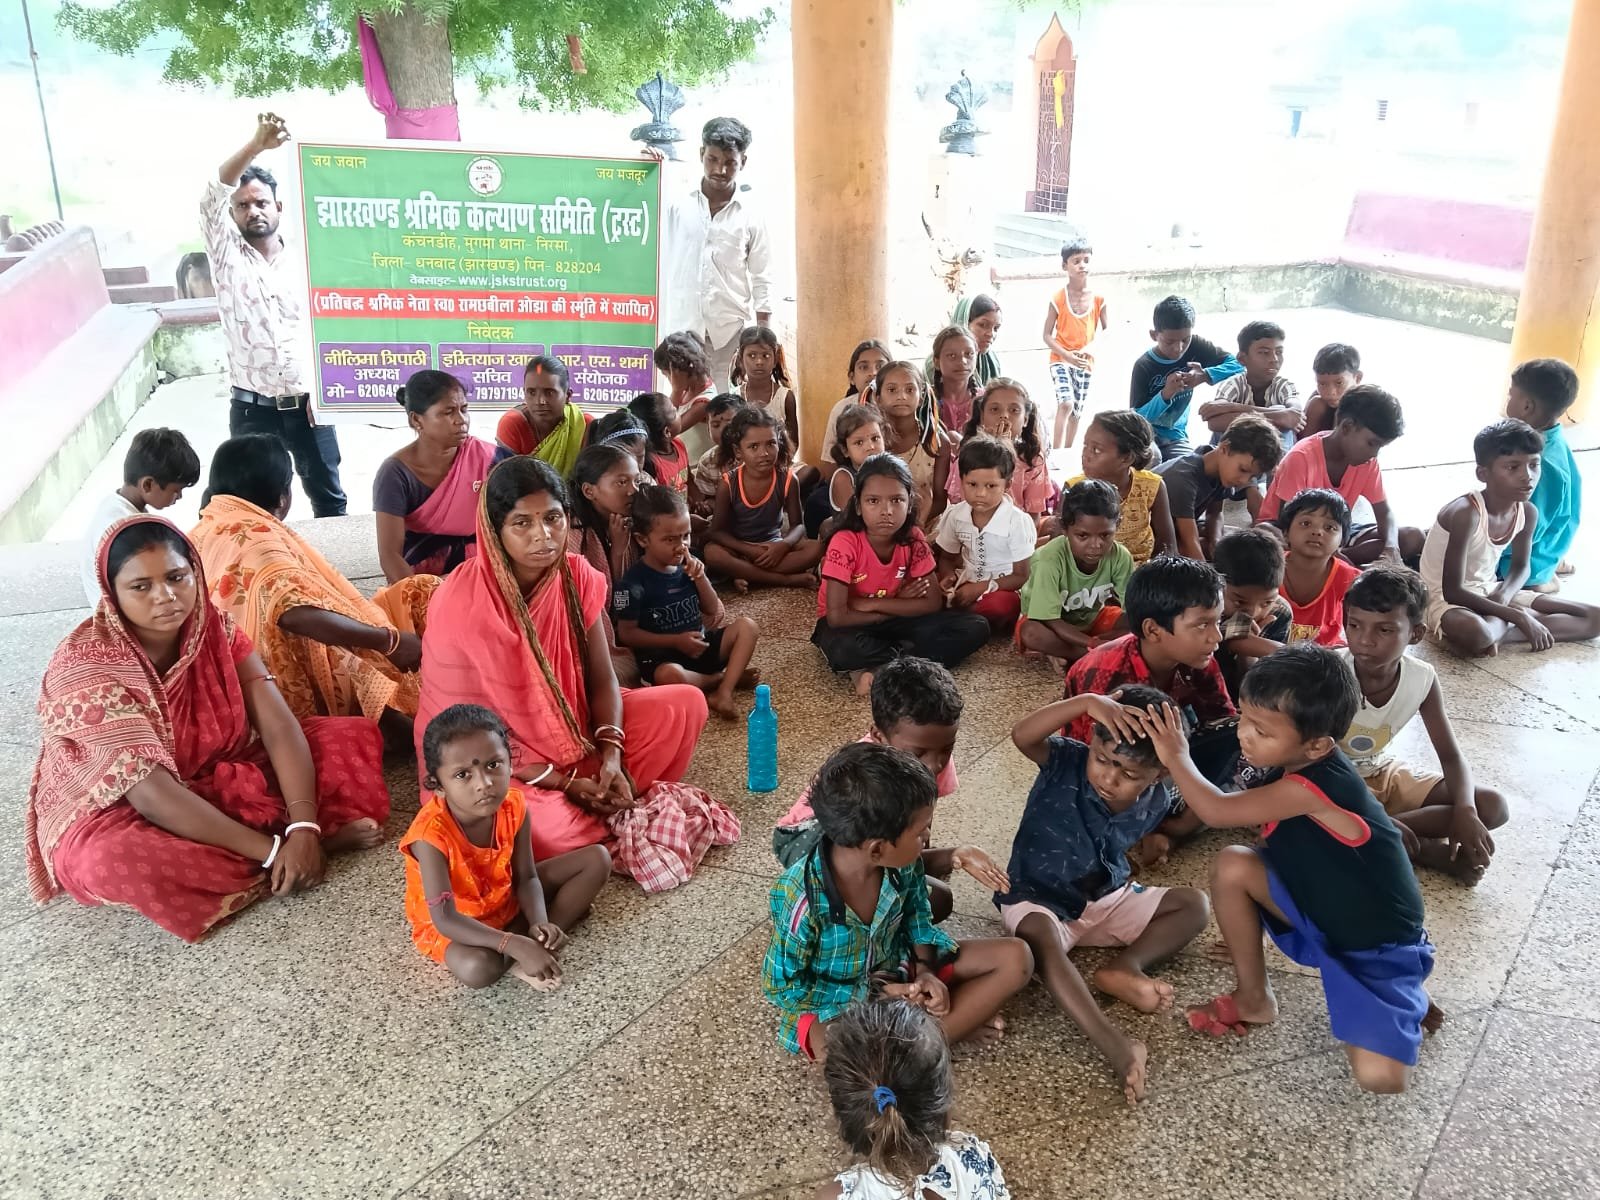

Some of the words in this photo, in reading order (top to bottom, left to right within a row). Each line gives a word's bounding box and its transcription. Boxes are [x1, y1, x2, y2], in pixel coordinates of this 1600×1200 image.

[310, 154, 331, 168] जय
[334, 155, 367, 169] जवान
[595, 167, 614, 181] जय
[616, 168, 648, 185] मजदूर
[314, 196, 400, 229] झारखण्ड
[403, 190, 463, 231] श्रमिक
[464, 200, 536, 234] कल्याण
[539, 196, 597, 235] समिति
[602, 199, 650, 245] (ट्रस्ट)
[463, 236, 496, 254] मुगमा
[555, 260, 602, 274] 828204
[458, 274, 567, 291] www.jskstrust.org
[368, 292, 405, 312] श्रमिक
[407, 293, 431, 312] नेता
[517, 296, 548, 314] ओझा
[551, 296, 566, 314] की
[569, 297, 596, 319] स्मृति
[599, 297, 610, 315] में
[467, 321, 515, 341] निवेदक
[323, 349, 378, 366] नीलिमा
[380, 349, 428, 366] त्रिपाठी
[441, 349, 506, 368] इम्तियाज
[507, 353, 540, 366] खा
[619, 354, 649, 370] शर्मा
[353, 367, 401, 382] अध्यक्ष
[471, 367, 513, 384] सचिव
[573, 367, 629, 386] संयोजक
[357, 383, 406, 398] 620649
[583, 387, 646, 403] 620612564
